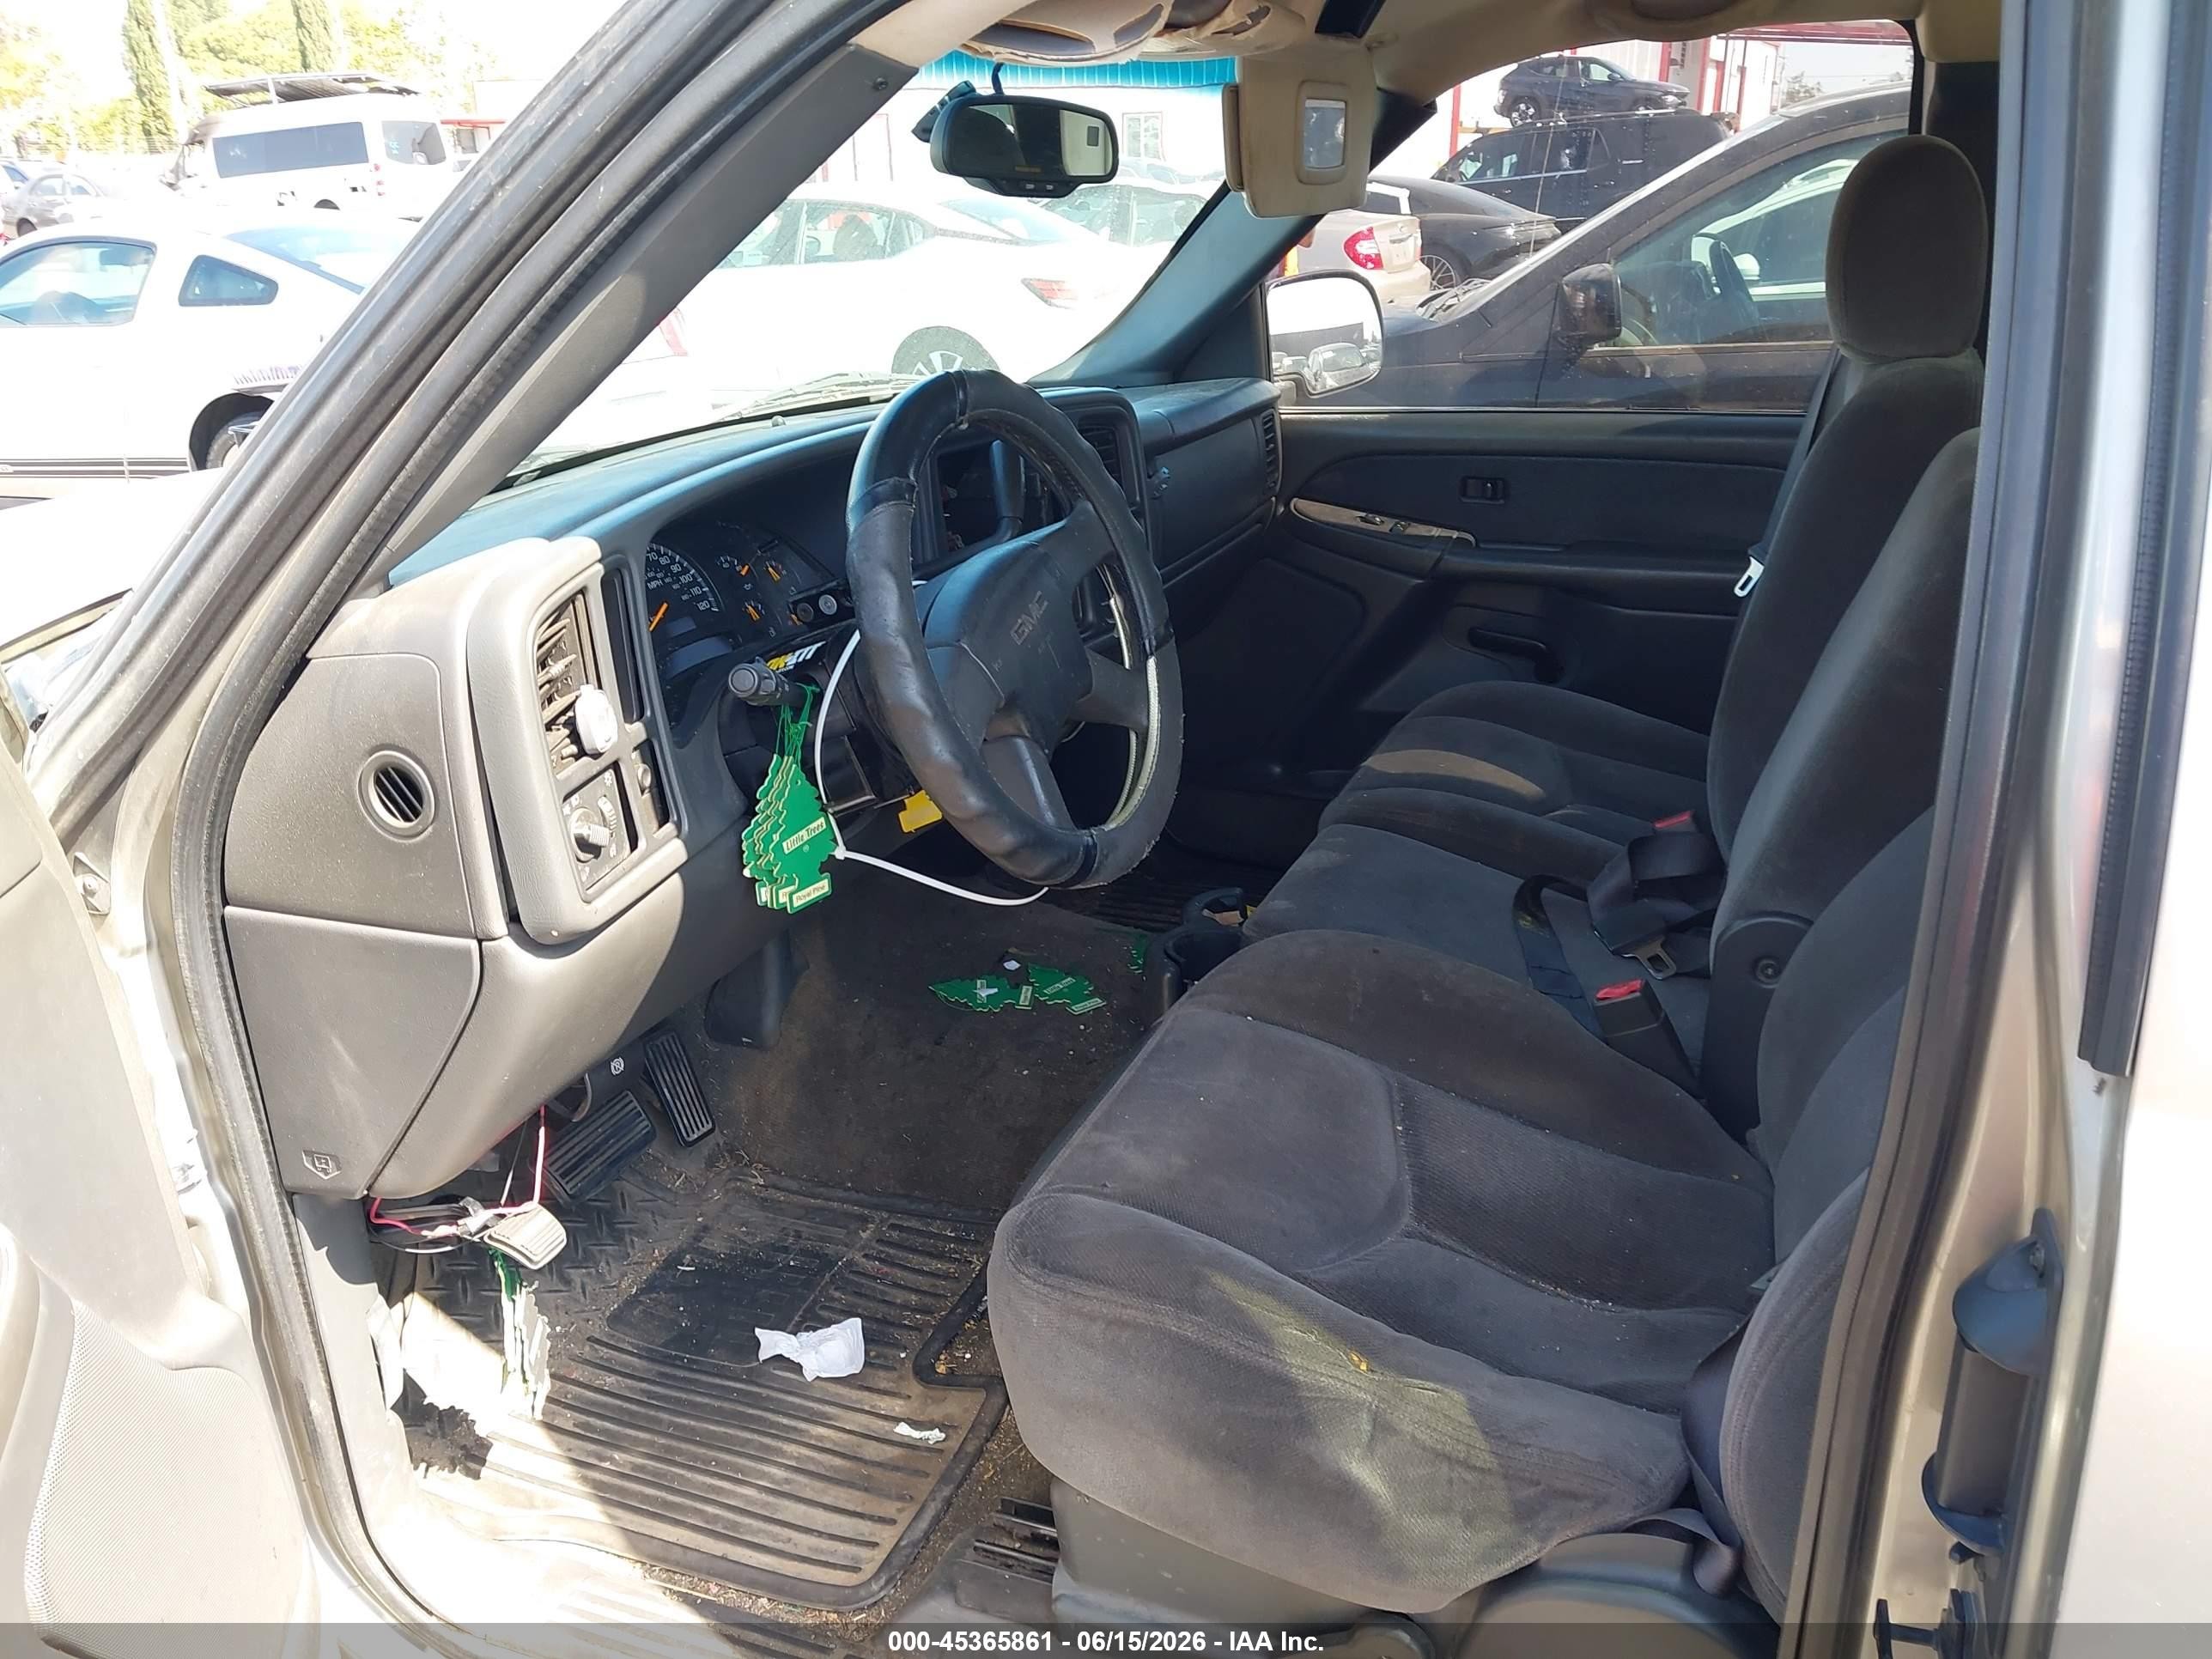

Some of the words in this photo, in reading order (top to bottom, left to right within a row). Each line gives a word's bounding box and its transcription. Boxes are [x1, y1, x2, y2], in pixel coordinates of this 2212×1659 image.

[647, 552, 659, 562] 70
[659, 556, 671, 565] 80
[670, 563, 683, 574] 90
[647, 579, 664, 590] MPH
[679, 574, 693, 584] 100
[690, 586, 702, 597] 110
[696, 600, 710, 611] 120
[1010, 590, 1048, 645] GMC
[785, 834, 805, 852] Little
[805, 821, 825, 838] Trees
[795, 887, 812, 903] Royal
